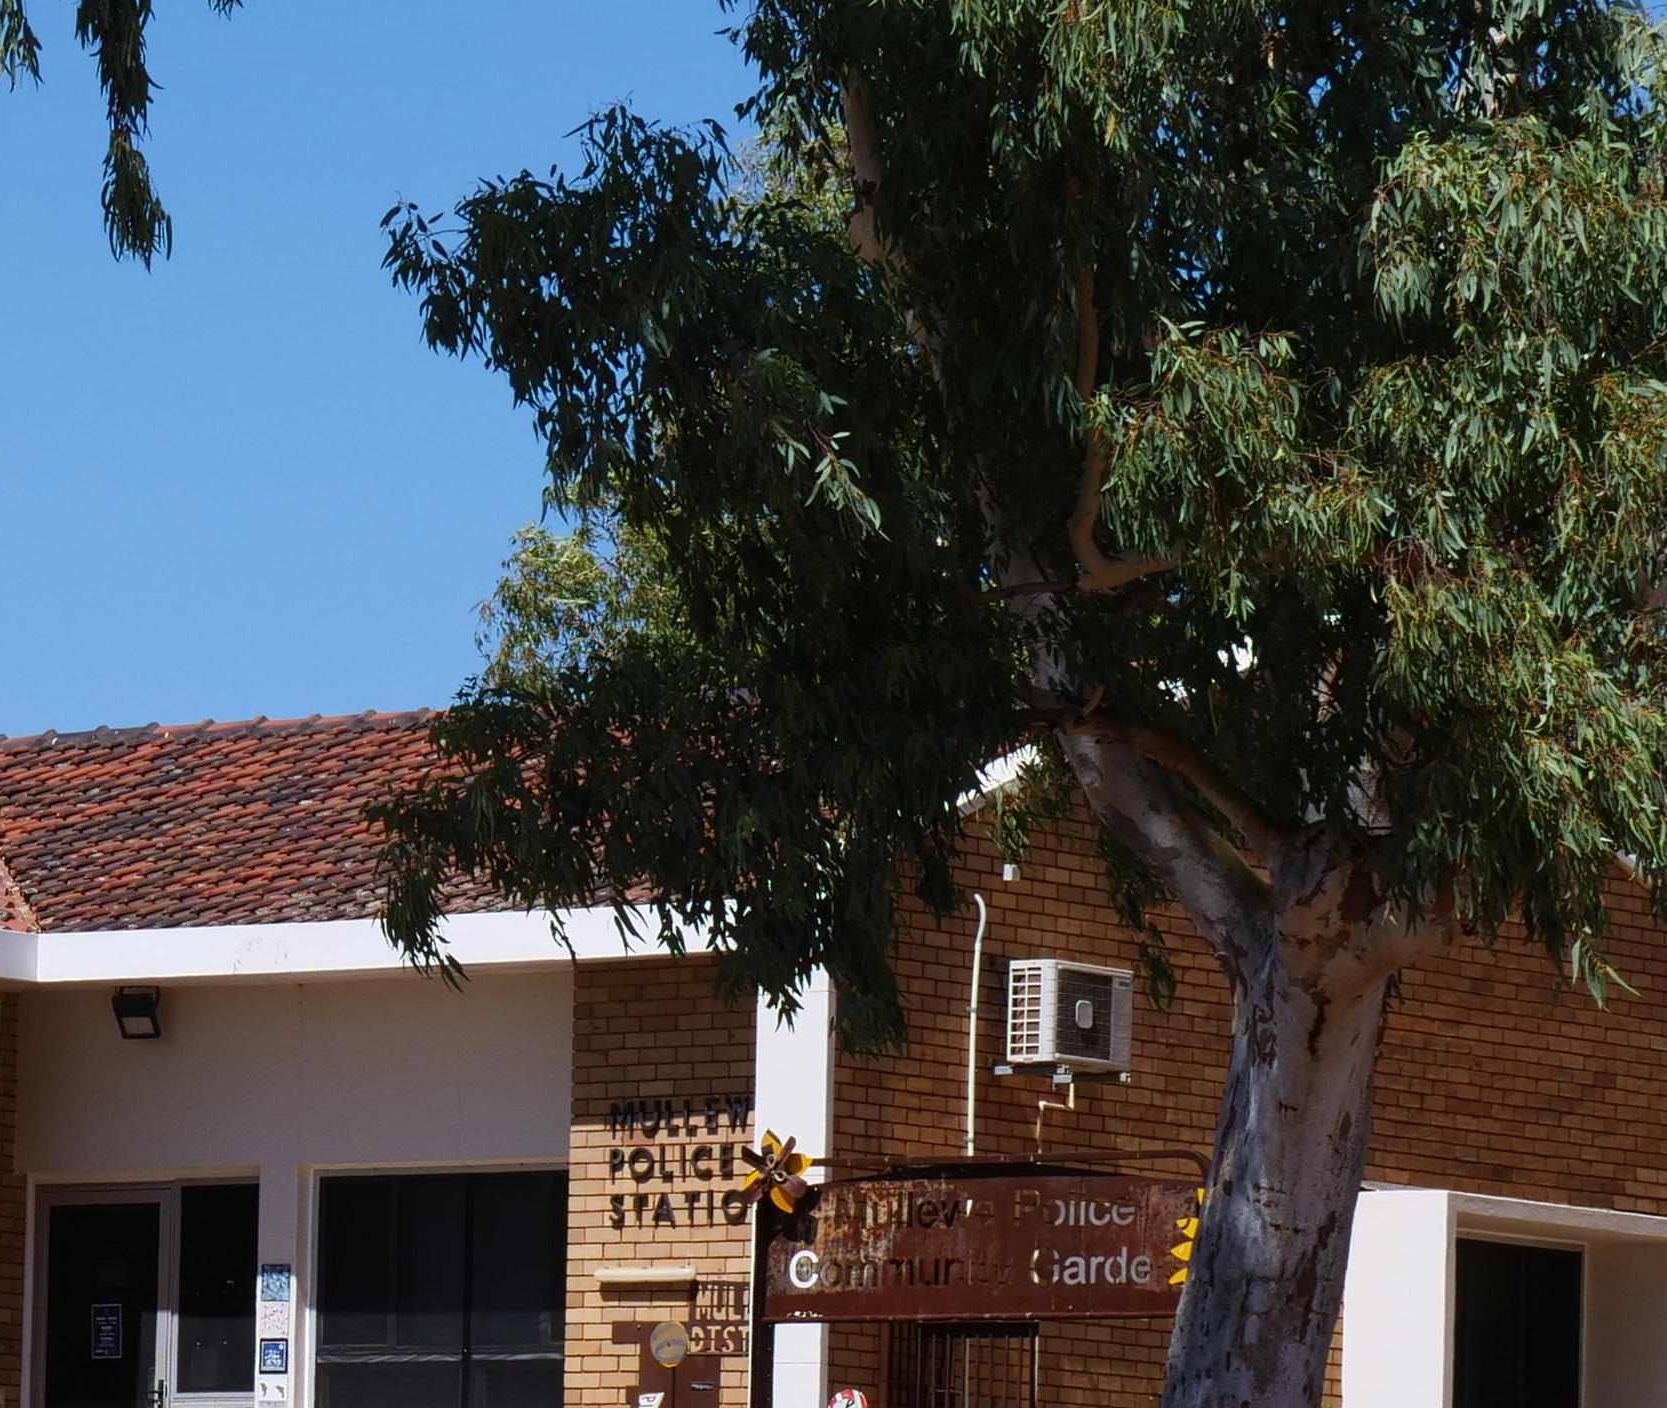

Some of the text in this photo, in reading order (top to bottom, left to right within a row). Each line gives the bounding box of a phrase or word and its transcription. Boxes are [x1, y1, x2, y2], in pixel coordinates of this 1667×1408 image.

[609, 1095, 750, 1138] MULLEW
[609, 1143, 735, 1184] POLICE
[609, 1189, 747, 1230] STATIO
[1014, 1189, 1135, 1227] Police
[1029, 1246, 1167, 1285] Garde
[690, 1325, 750, 1352] DIST
